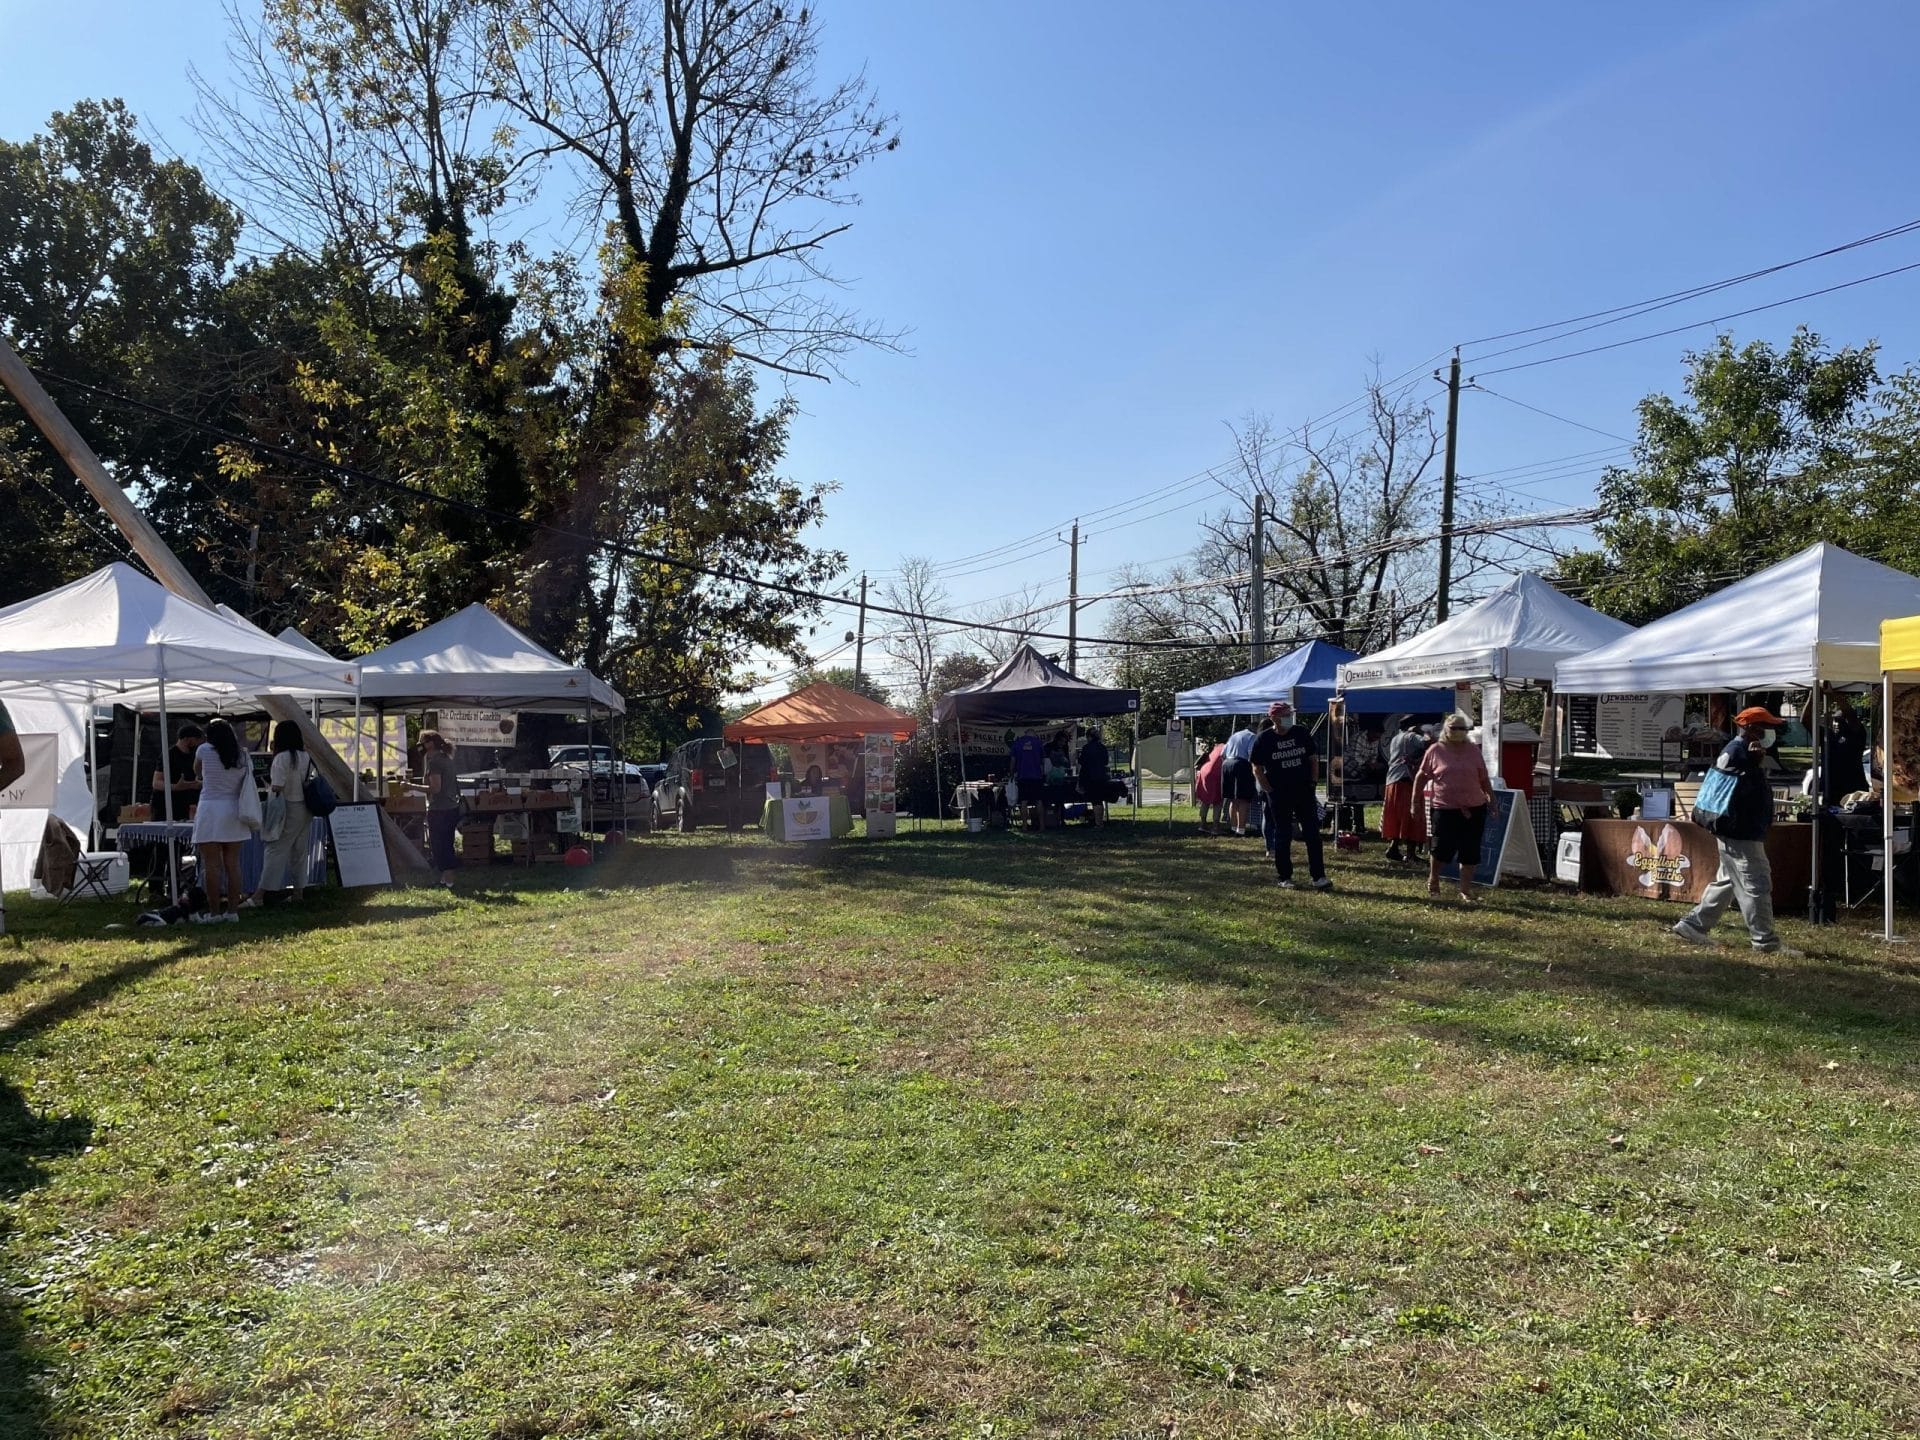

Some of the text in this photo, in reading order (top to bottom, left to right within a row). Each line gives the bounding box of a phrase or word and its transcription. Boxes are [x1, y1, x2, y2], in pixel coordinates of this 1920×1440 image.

[1345, 669, 1383, 683] Orwashers
[439, 709, 449, 720] The
[1277, 738, 1296, 750] BEST
[1272, 747, 1306, 760] GRANDPA
[1281, 758, 1302, 769] EVER
[9, 789, 26, 801] NY
